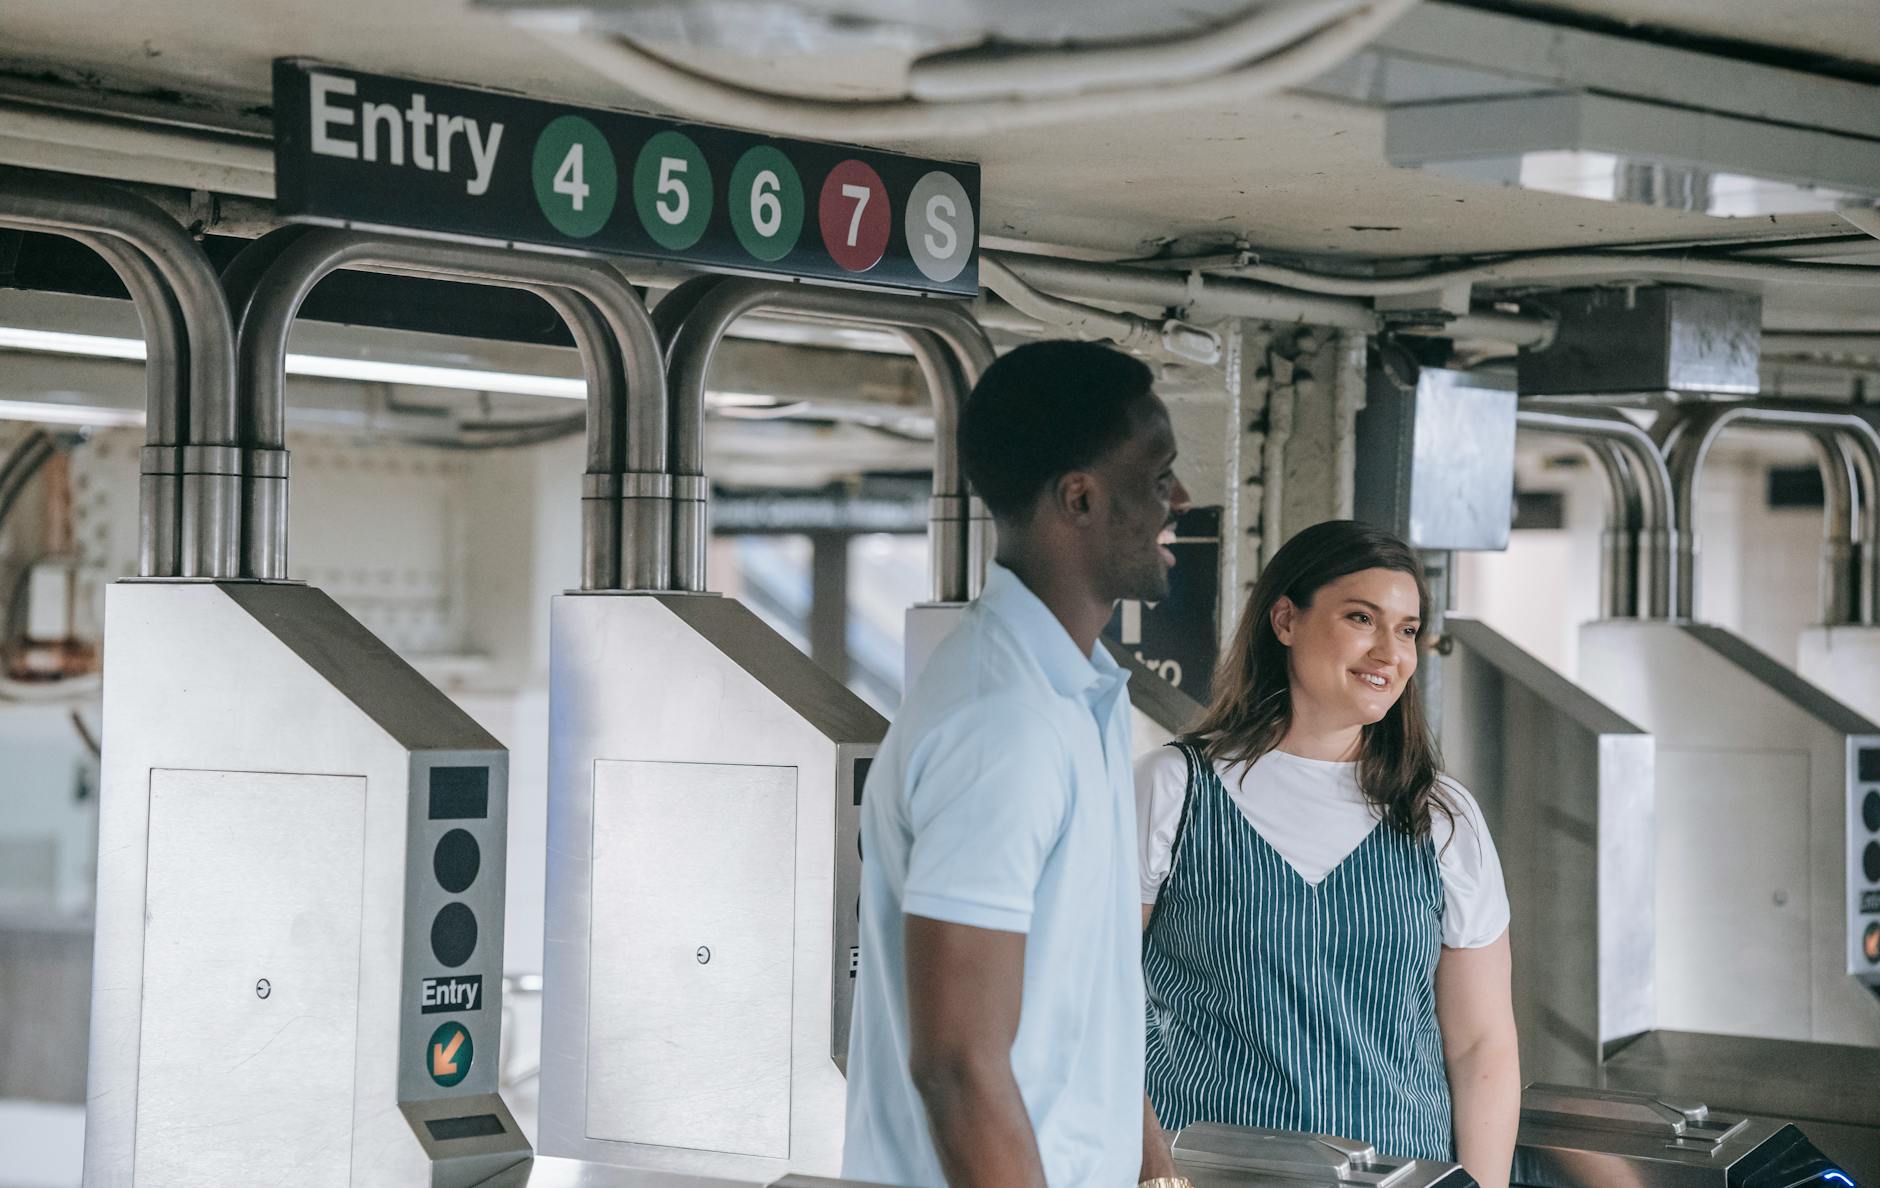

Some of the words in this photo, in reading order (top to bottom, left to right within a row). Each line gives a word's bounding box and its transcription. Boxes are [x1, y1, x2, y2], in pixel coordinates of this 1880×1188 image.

[309, 71, 505, 196] Entry
[553, 143, 590, 212] 4
[656, 156, 690, 225] 5
[751, 169, 782, 238] 6
[841, 183, 871, 247] 7
[924, 194, 957, 260] S
[422, 979, 479, 1010] Entry
